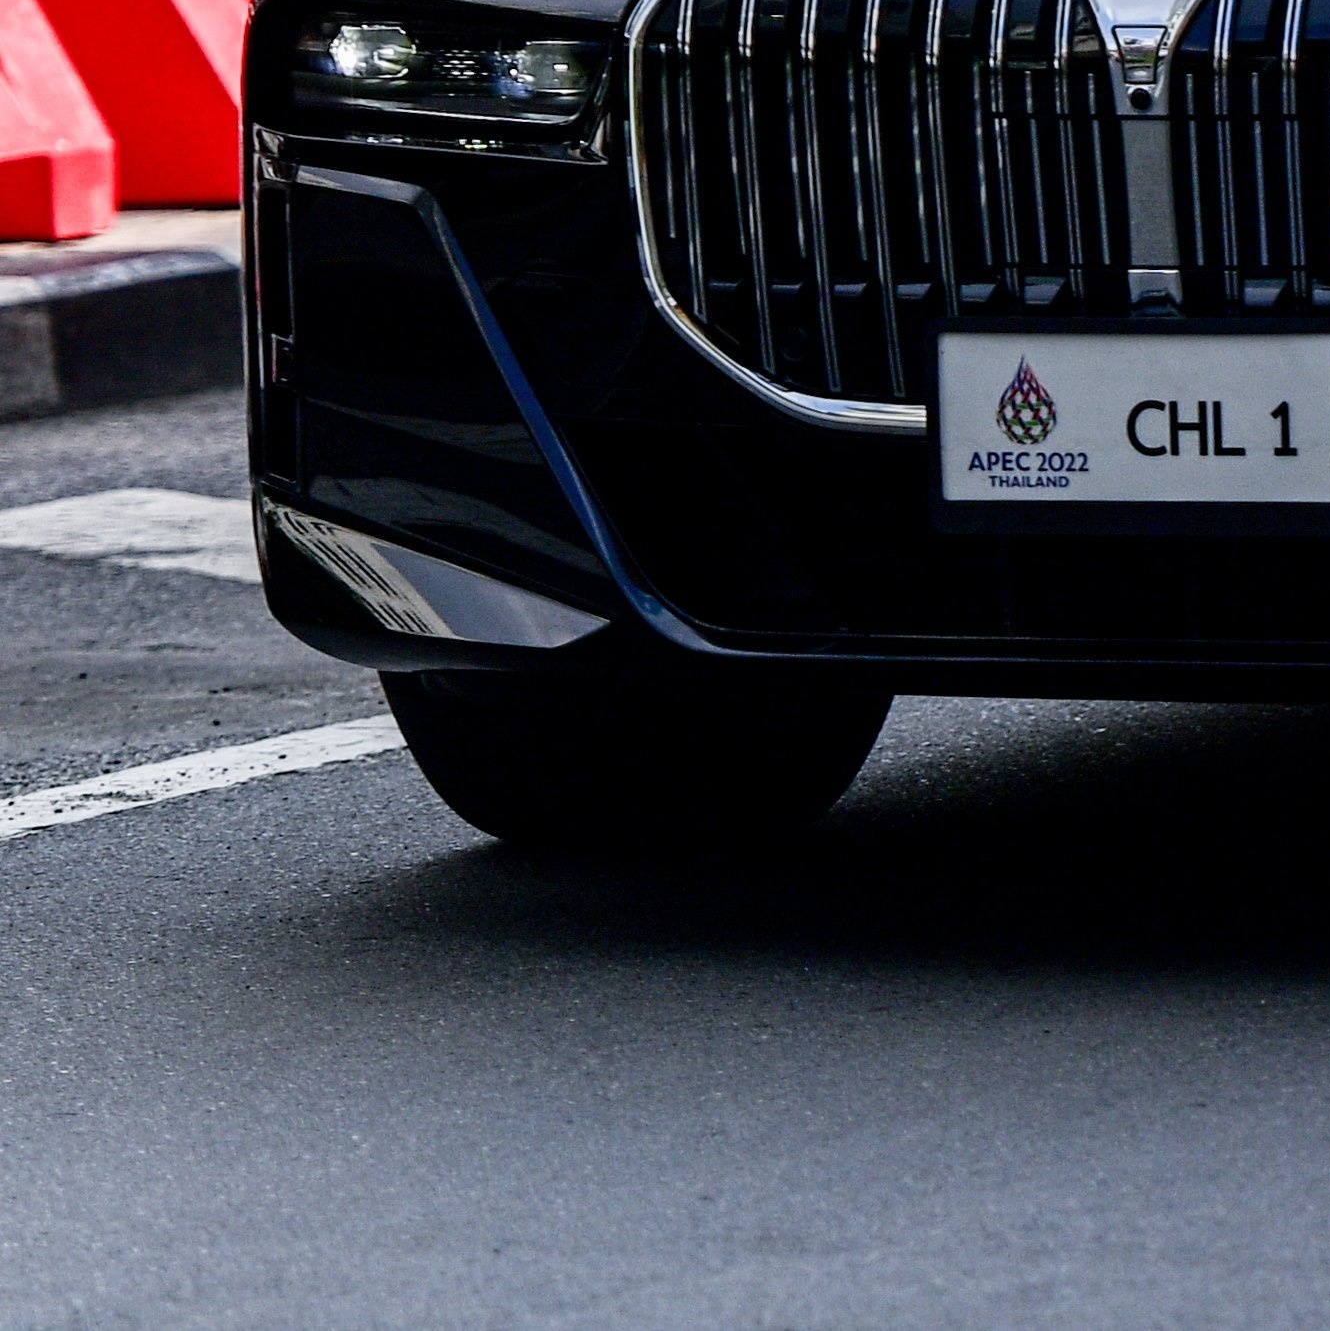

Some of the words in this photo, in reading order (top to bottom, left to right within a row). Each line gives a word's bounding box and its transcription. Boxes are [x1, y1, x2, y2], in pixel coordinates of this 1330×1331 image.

[1126, 399, 1246, 457] CHL
[1270, 400, 1298, 457] 1
[968, 451, 1031, 472] APEC
[1035, 451, 1089, 472] 2022
[988, 474, 1070, 488] THAILAND
